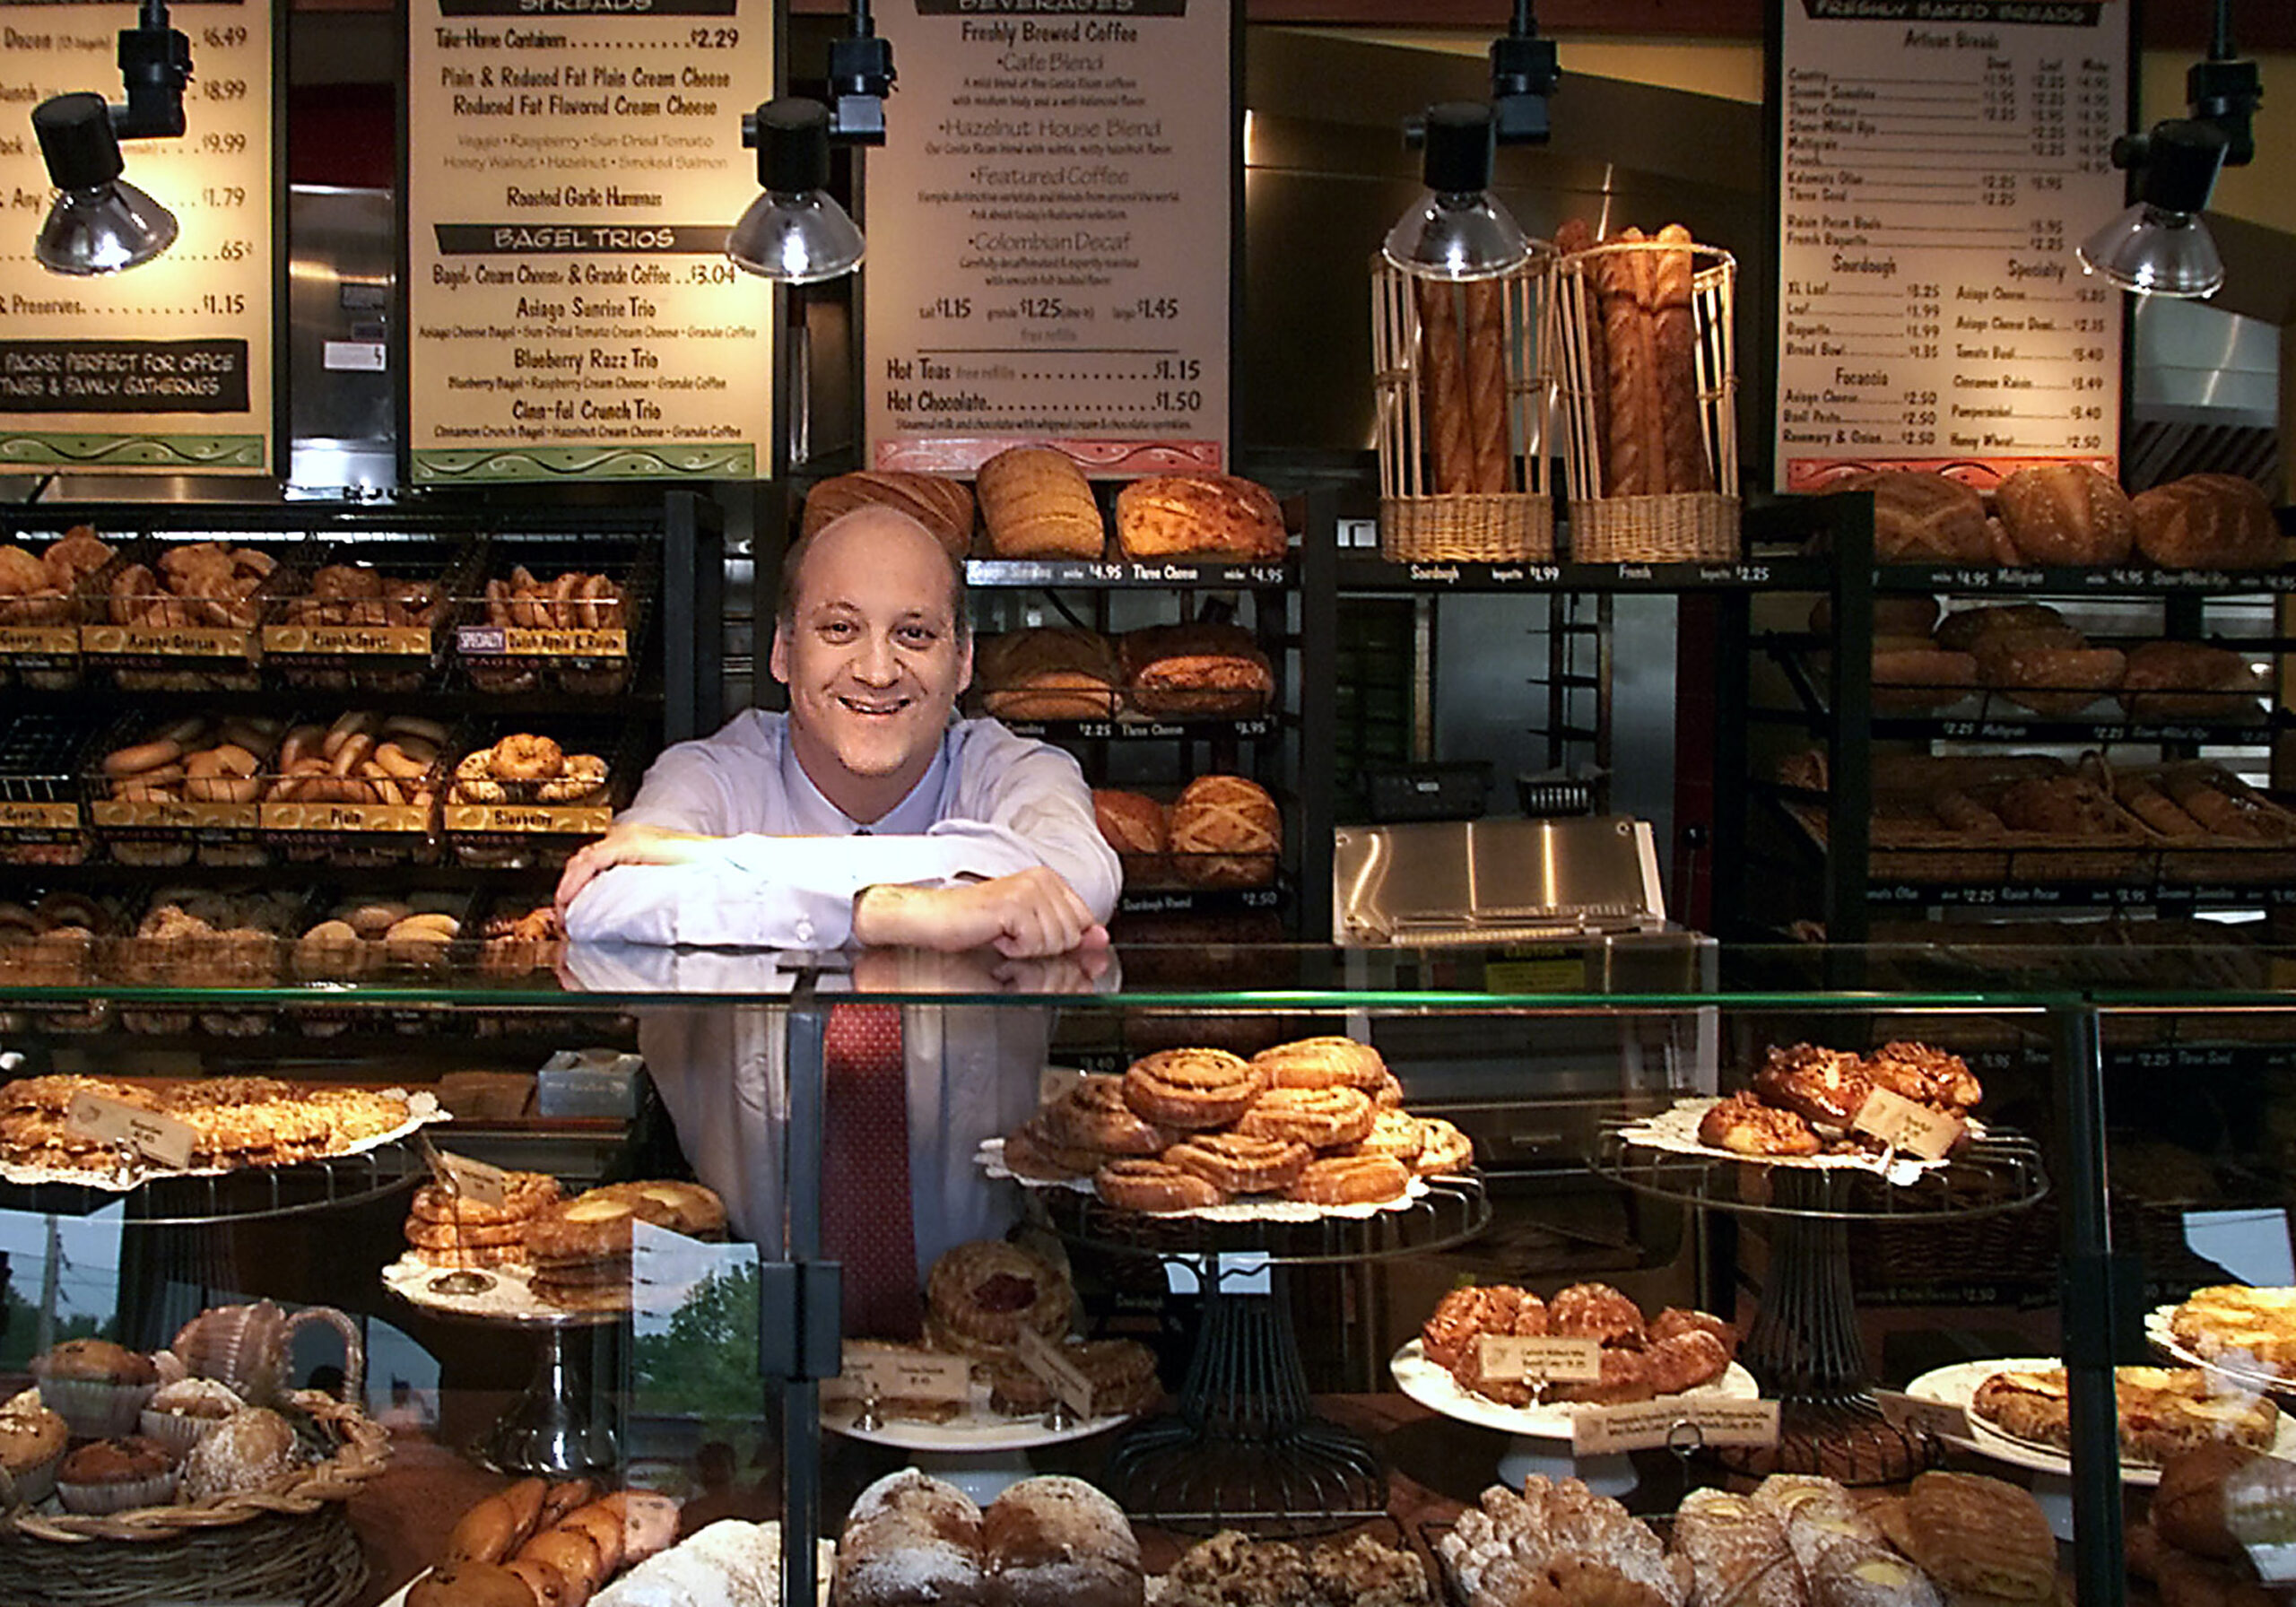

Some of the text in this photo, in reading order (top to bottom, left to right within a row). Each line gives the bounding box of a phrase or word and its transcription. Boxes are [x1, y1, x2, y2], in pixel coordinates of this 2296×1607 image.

[691, 28, 739, 48] $2.29
[961, 21, 1139, 47] Freshly Brewed Coffee
[441, 66, 730, 88] Plain & Reduced Fat Plain Cream Cheese
[454, 95, 718, 116] Reduced Fat Flavored Cream Cheese
[507, 186, 561, 207] Roasted
[565, 186, 603, 207] Garlic
[494, 227, 675, 249] BAGEL TRIOS
[476, 264, 515, 285] Cream
[568, 264, 582, 285] &
[585, 264, 628, 285] Grande
[631, 264, 672, 285] Coffee
[204, 293, 246, 315] $1.15
[516, 295, 657, 325] Asiago Sunrise Trio
[515, 347, 659, 375] Blueberry Razz Trio
[887, 359, 912, 380] Hot
[918, 359, 952, 380] Teas
[580, 399, 631, 421] Crunch
[632, 398, 661, 421] Trio
[887, 390, 987, 413] Hot Chocolate
[1156, 390, 1202, 413] $1.50
